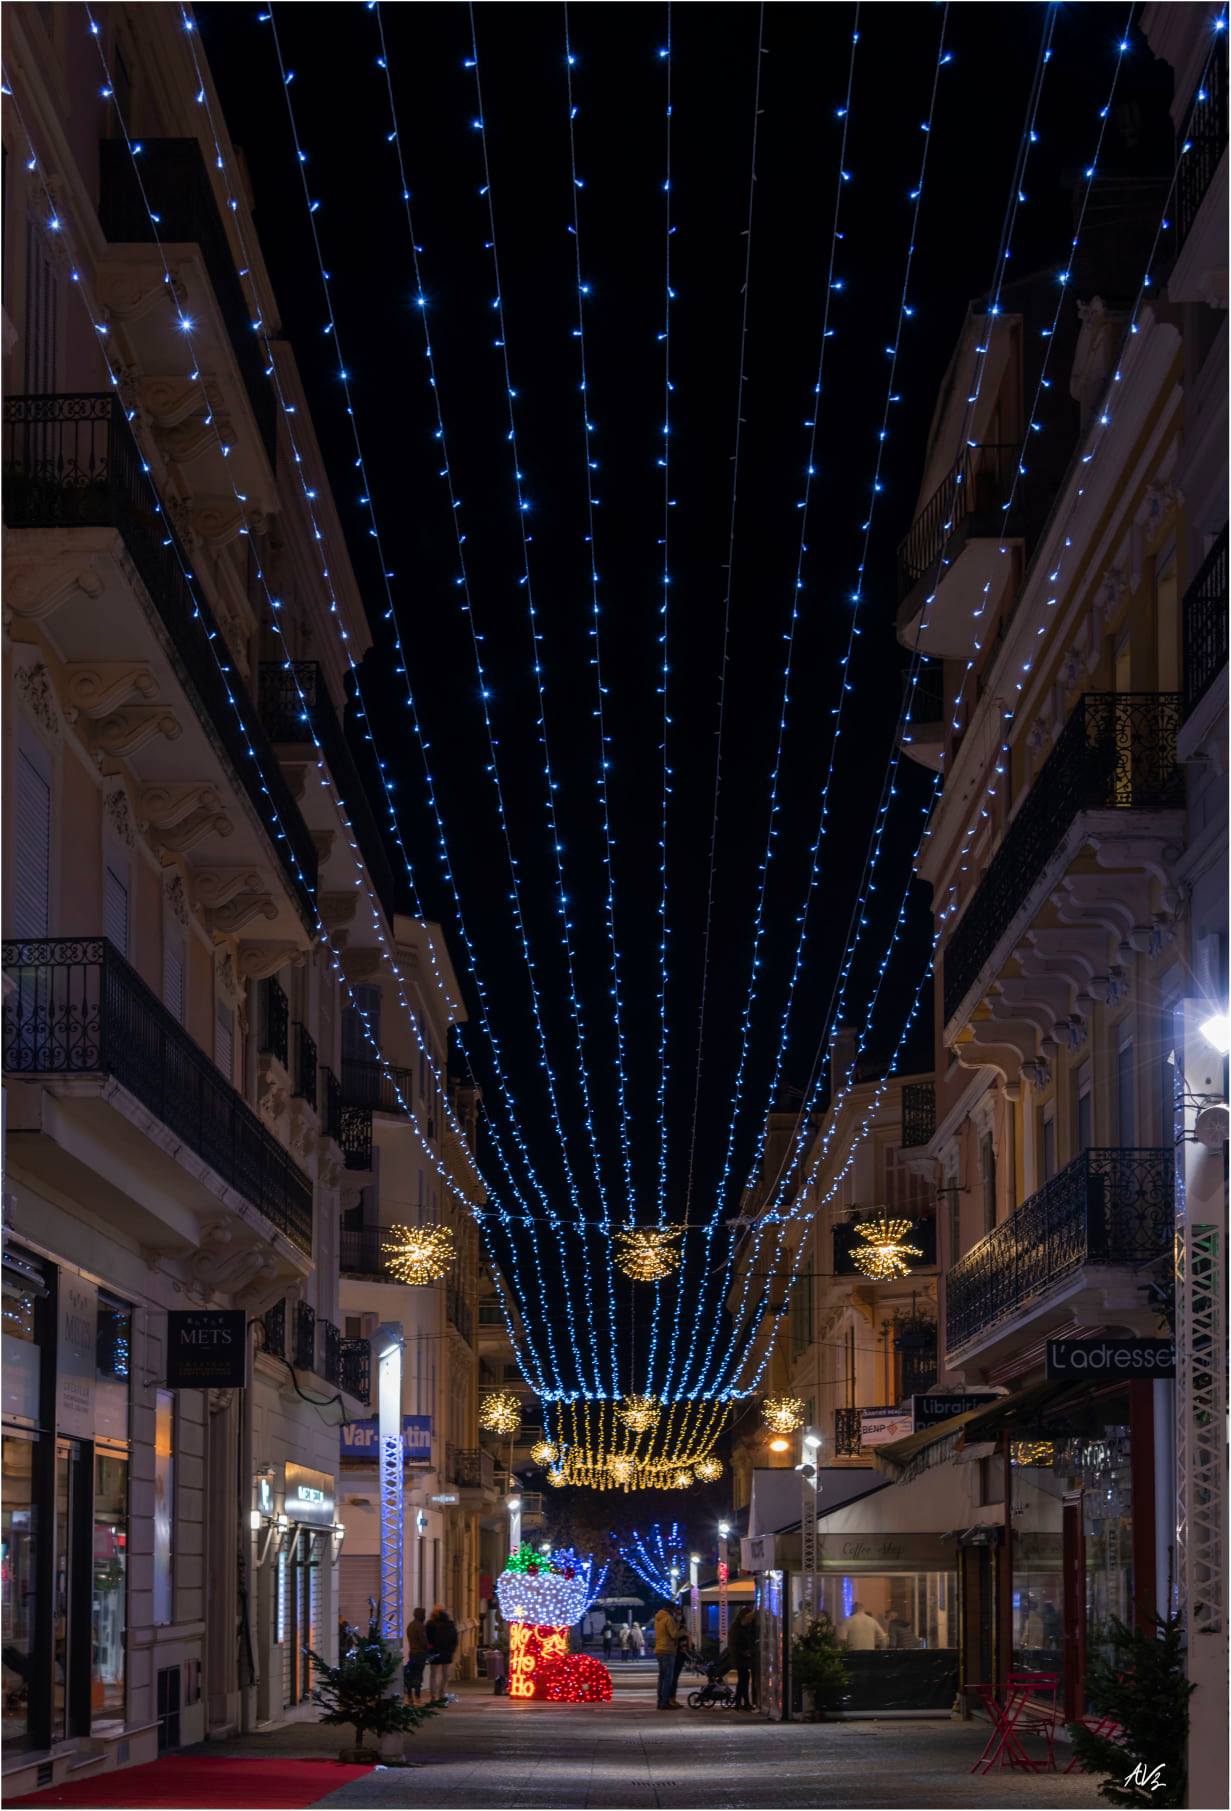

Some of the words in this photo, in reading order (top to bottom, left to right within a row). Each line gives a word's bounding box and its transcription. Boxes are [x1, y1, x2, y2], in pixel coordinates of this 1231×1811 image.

[180, 1329, 232, 1345] METS
[1052, 1344, 1172, 1368] L'adresse
[343, 1422, 430, 1447] Var-tin
[842, 1542, 871, 1560] Coffee
[510, 1648, 535, 1674] Ho
[510, 1674, 534, 1696] Ho
